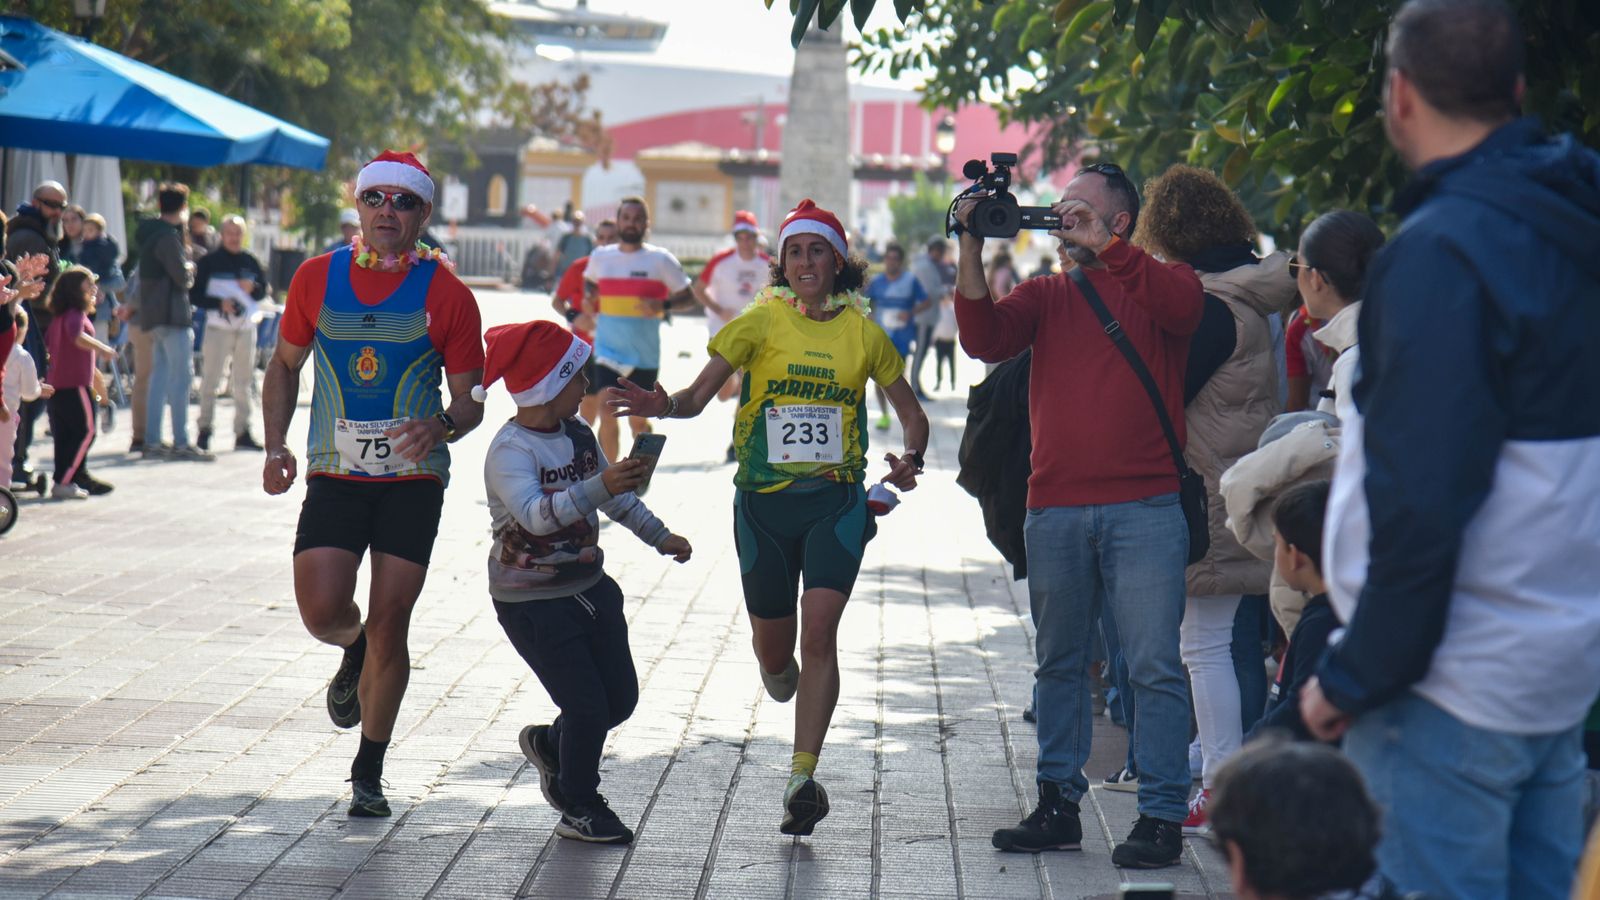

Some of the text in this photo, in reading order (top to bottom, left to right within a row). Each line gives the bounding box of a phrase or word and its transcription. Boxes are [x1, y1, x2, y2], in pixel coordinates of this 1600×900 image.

[787, 363, 836, 380] RUNNERS
[782, 422, 829, 445] 233
[356, 437, 391, 460] 75
